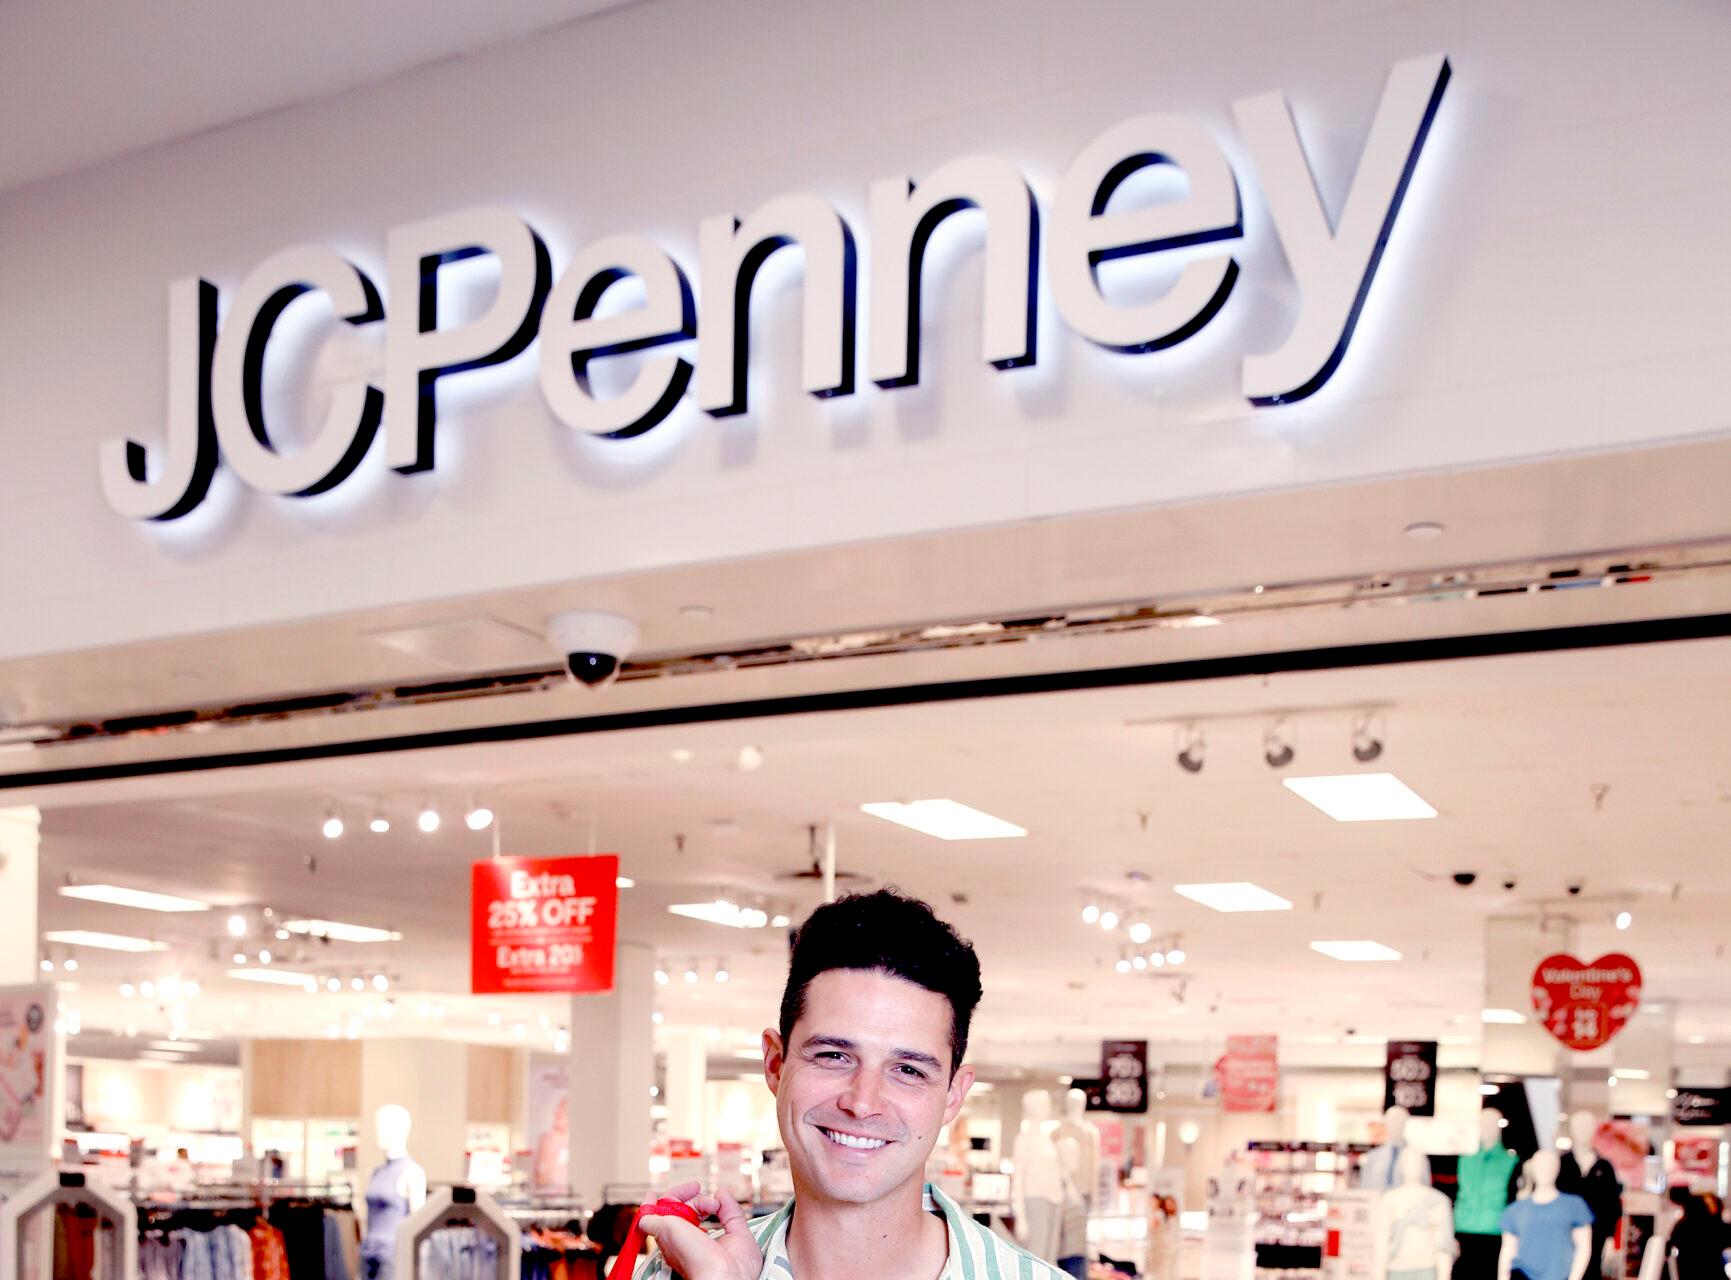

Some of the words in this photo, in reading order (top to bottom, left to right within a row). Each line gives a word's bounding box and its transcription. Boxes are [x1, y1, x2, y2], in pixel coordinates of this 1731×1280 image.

[100, 52, 1452, 522] JCPenney
[511, 871, 576, 898] Extra
[488, 899, 537, 928] 25%
[542, 897, 597, 925] OFF
